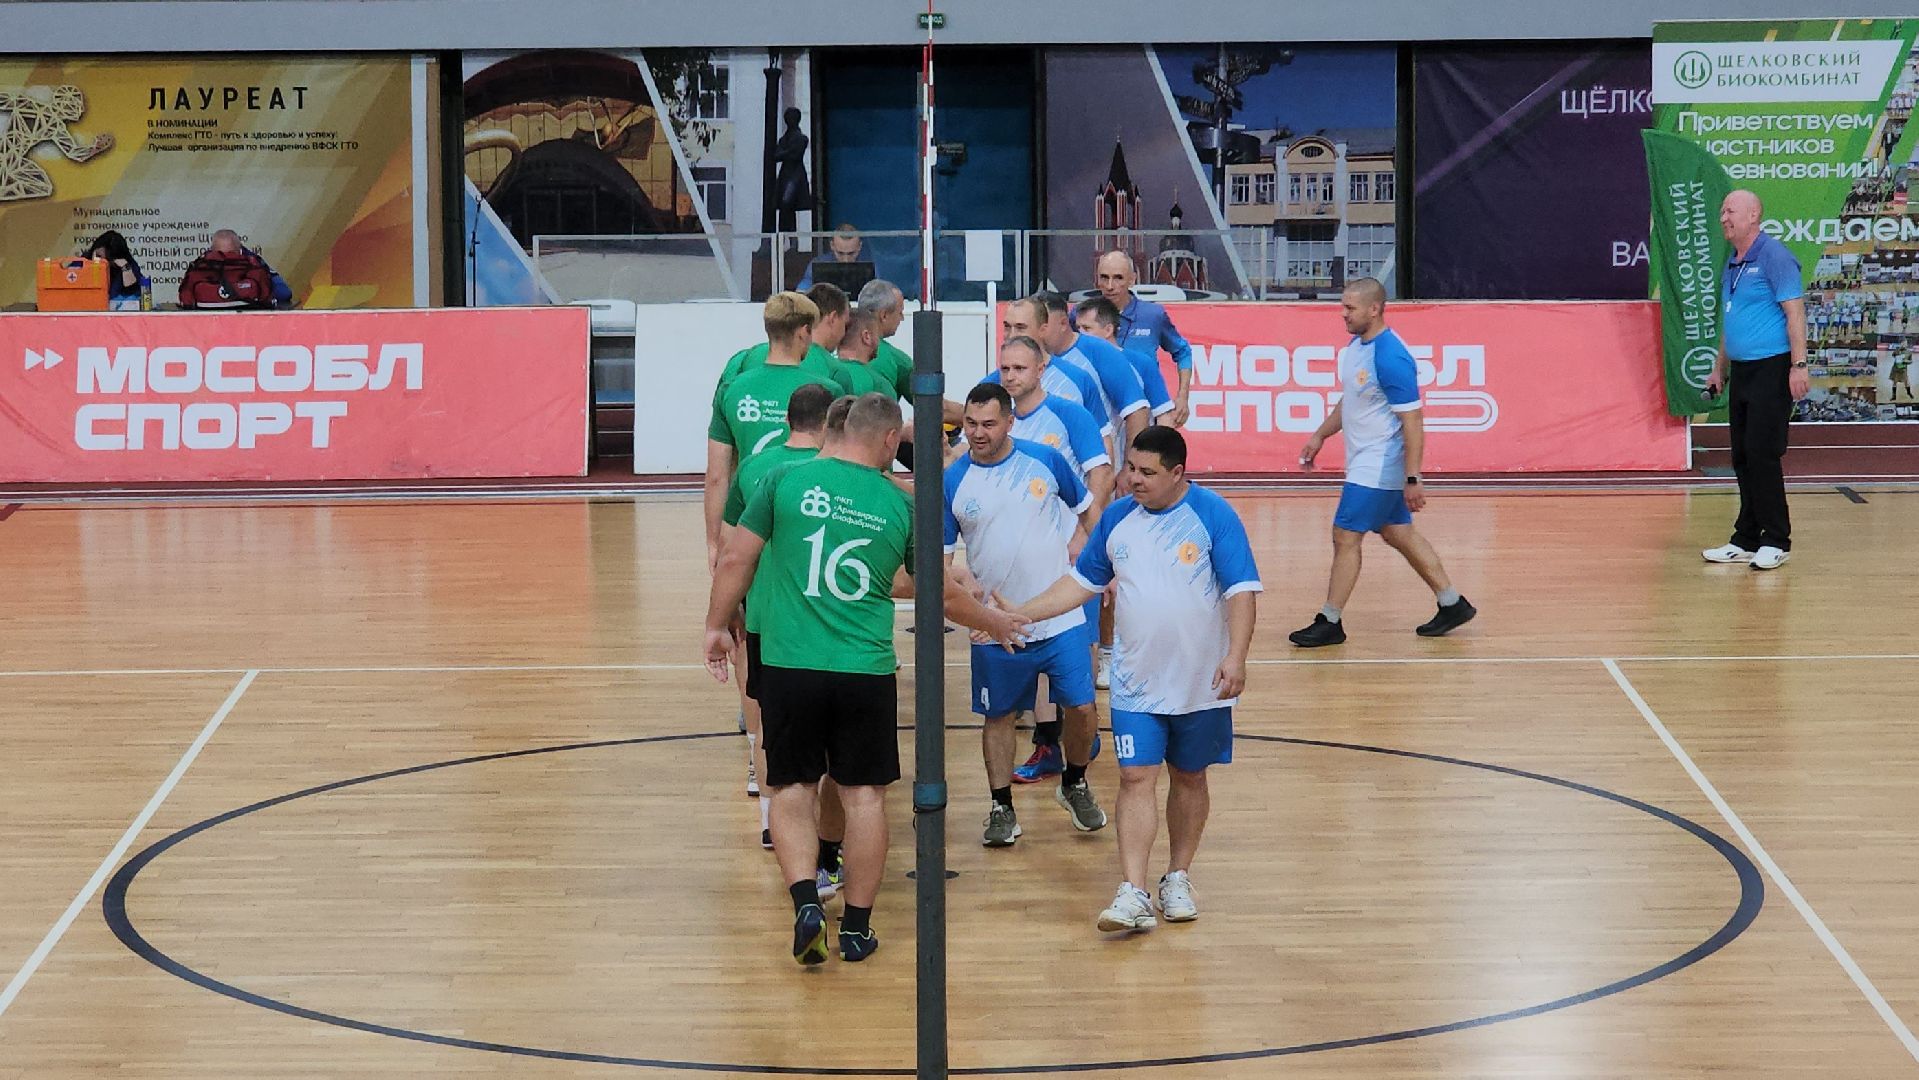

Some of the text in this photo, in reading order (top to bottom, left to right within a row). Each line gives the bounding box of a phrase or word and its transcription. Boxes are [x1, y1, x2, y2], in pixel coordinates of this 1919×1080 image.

[1717, 71, 1861, 87] БИОКОМБИНАТ
[148, 86, 308, 110] ЛАУРЕАТ
[1561, 85, 1653, 119] ЩЁЛК
[156, 119, 218, 128] НОМИНАЦИИ
[1678, 111, 1874, 136] Приветствуем
[148, 131, 192, 140] Комплекс
[194, 131, 213, 139] ГТО
[221, 133, 241, 141] путь
[252, 132, 296, 141] здоровью
[148, 143, 183, 152] Лучшая
[188, 144, 244, 152] организация
[260, 143, 310, 152] внедрению
[312, 142, 338, 150] ВФСК
[341, 142, 359, 150] ГТО
[73, 207, 160, 217] Муниципальное
[73, 221, 210, 231] автономное учреждение
[138, 235, 195, 243] поселения
[1690, 180, 1716, 340] БИОКОМБИНАТ
[76, 343, 424, 394] МОСОБЛ
[75, 401, 348, 451] СПОРТ
[803, 524, 873, 601] 16
[1114, 734, 1136, 759] 18
